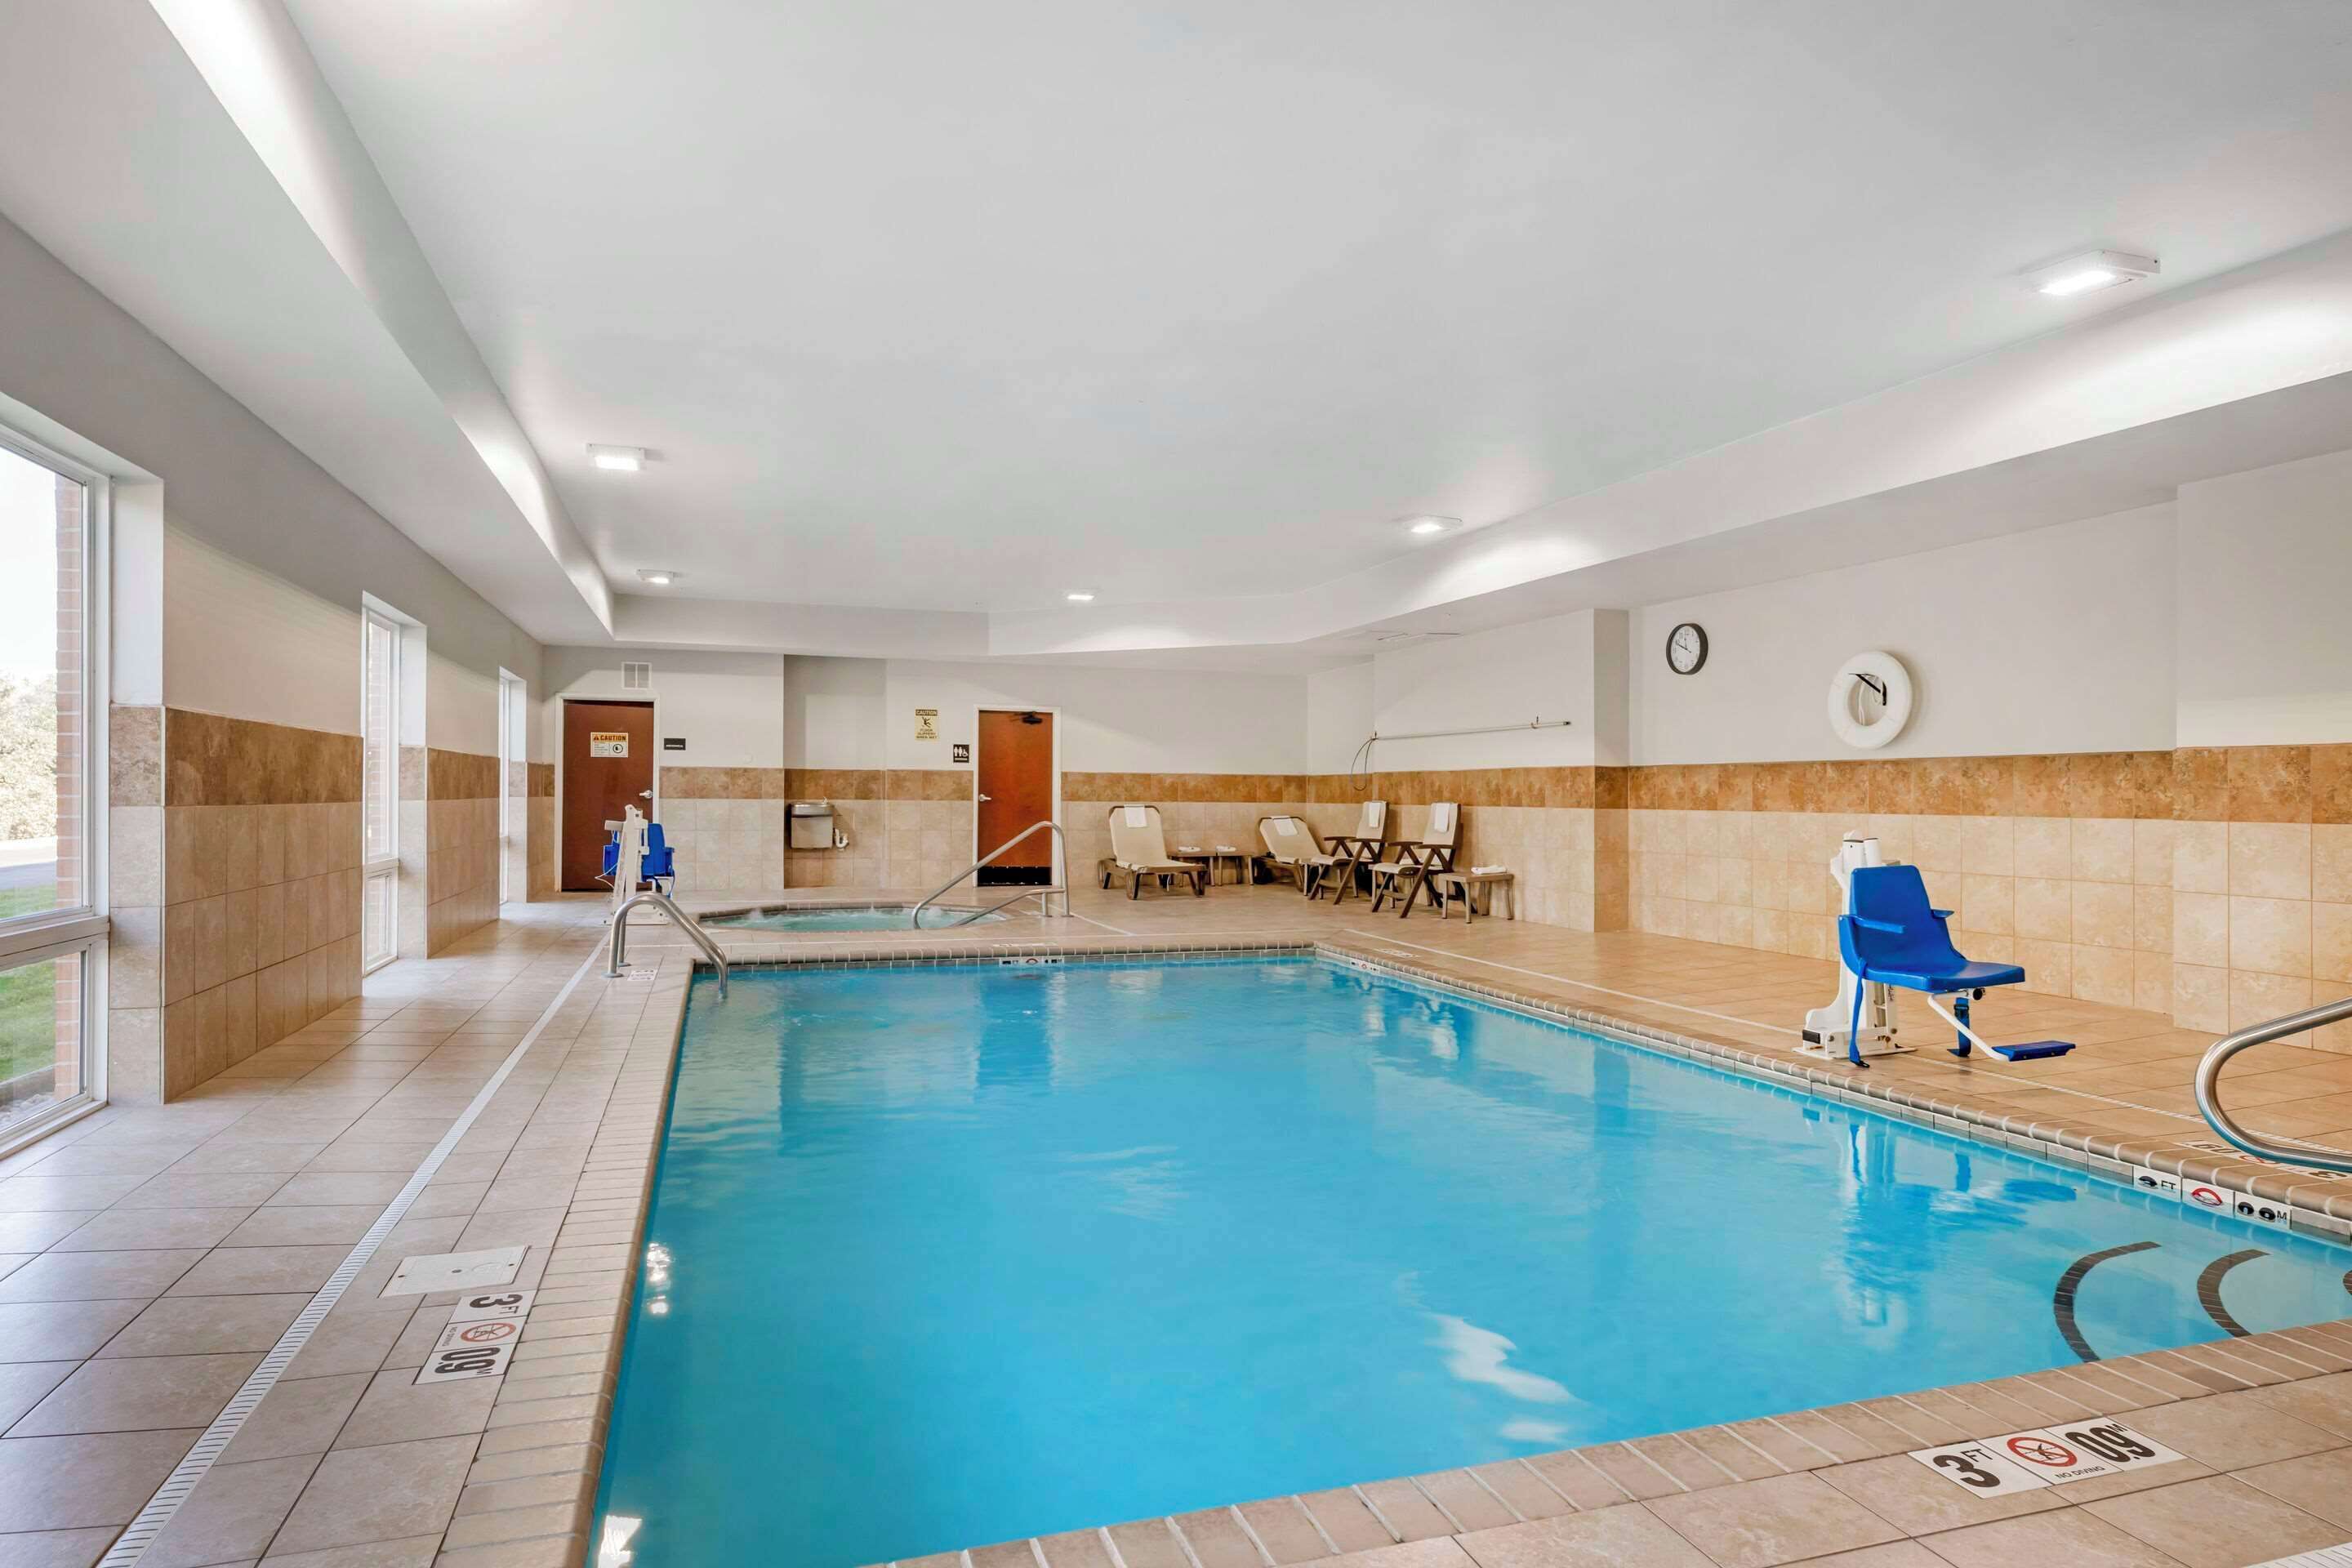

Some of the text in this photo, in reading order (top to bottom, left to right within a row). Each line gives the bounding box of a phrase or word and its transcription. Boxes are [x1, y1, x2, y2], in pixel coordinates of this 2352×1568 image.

[469, 1294, 523, 1314] 3 FT
[2105, 1423, 2127, 1434] M
[1932, 1449, 2001, 1487] 3 FT
[2072, 1466, 2105, 1477] DIVING
